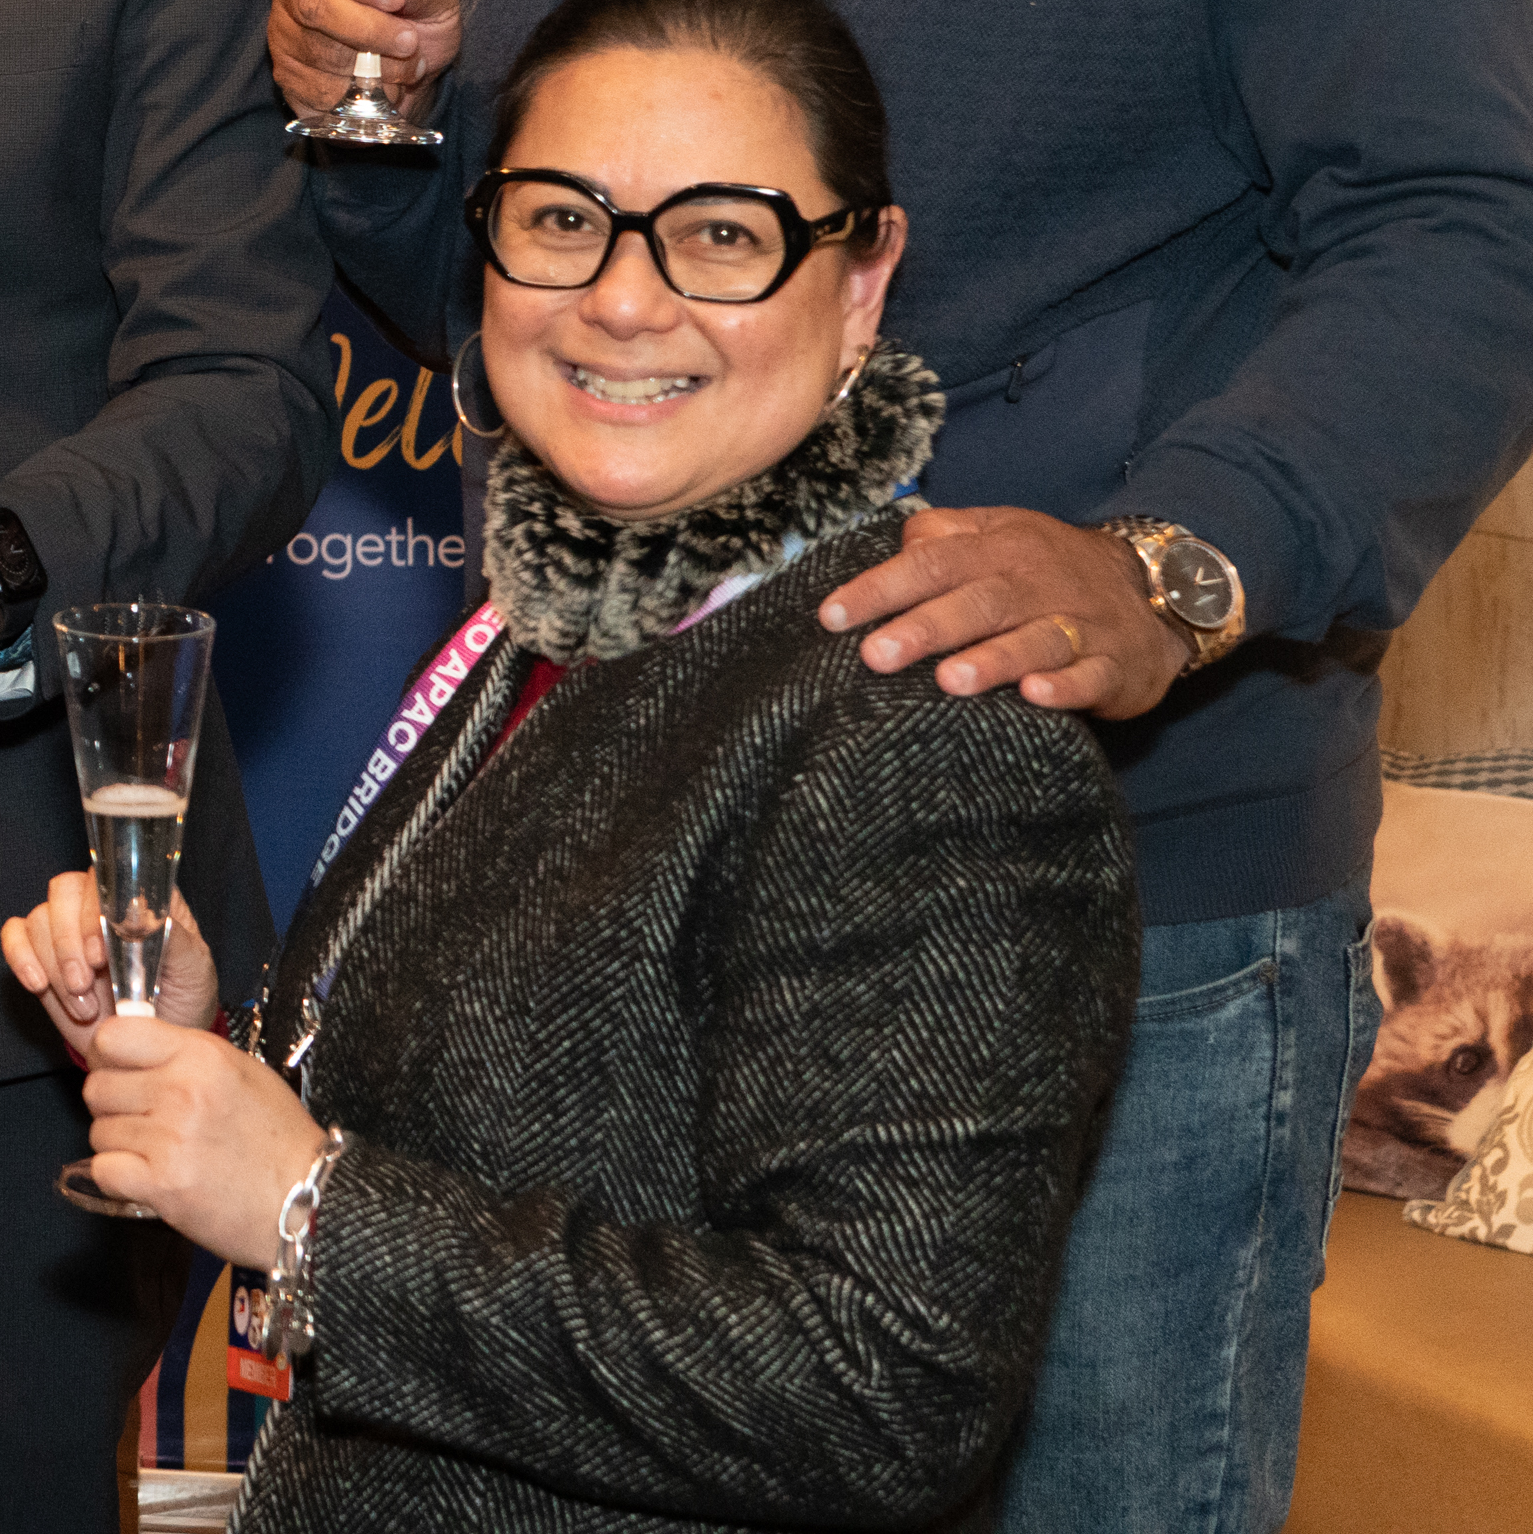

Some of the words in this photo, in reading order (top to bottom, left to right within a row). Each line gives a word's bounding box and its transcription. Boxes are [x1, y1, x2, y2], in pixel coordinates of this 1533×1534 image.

[266, 516, 466, 580] ogethe
[387, 647, 470, 754] APAC
[310, 747, 398, 889] BRIDGE
